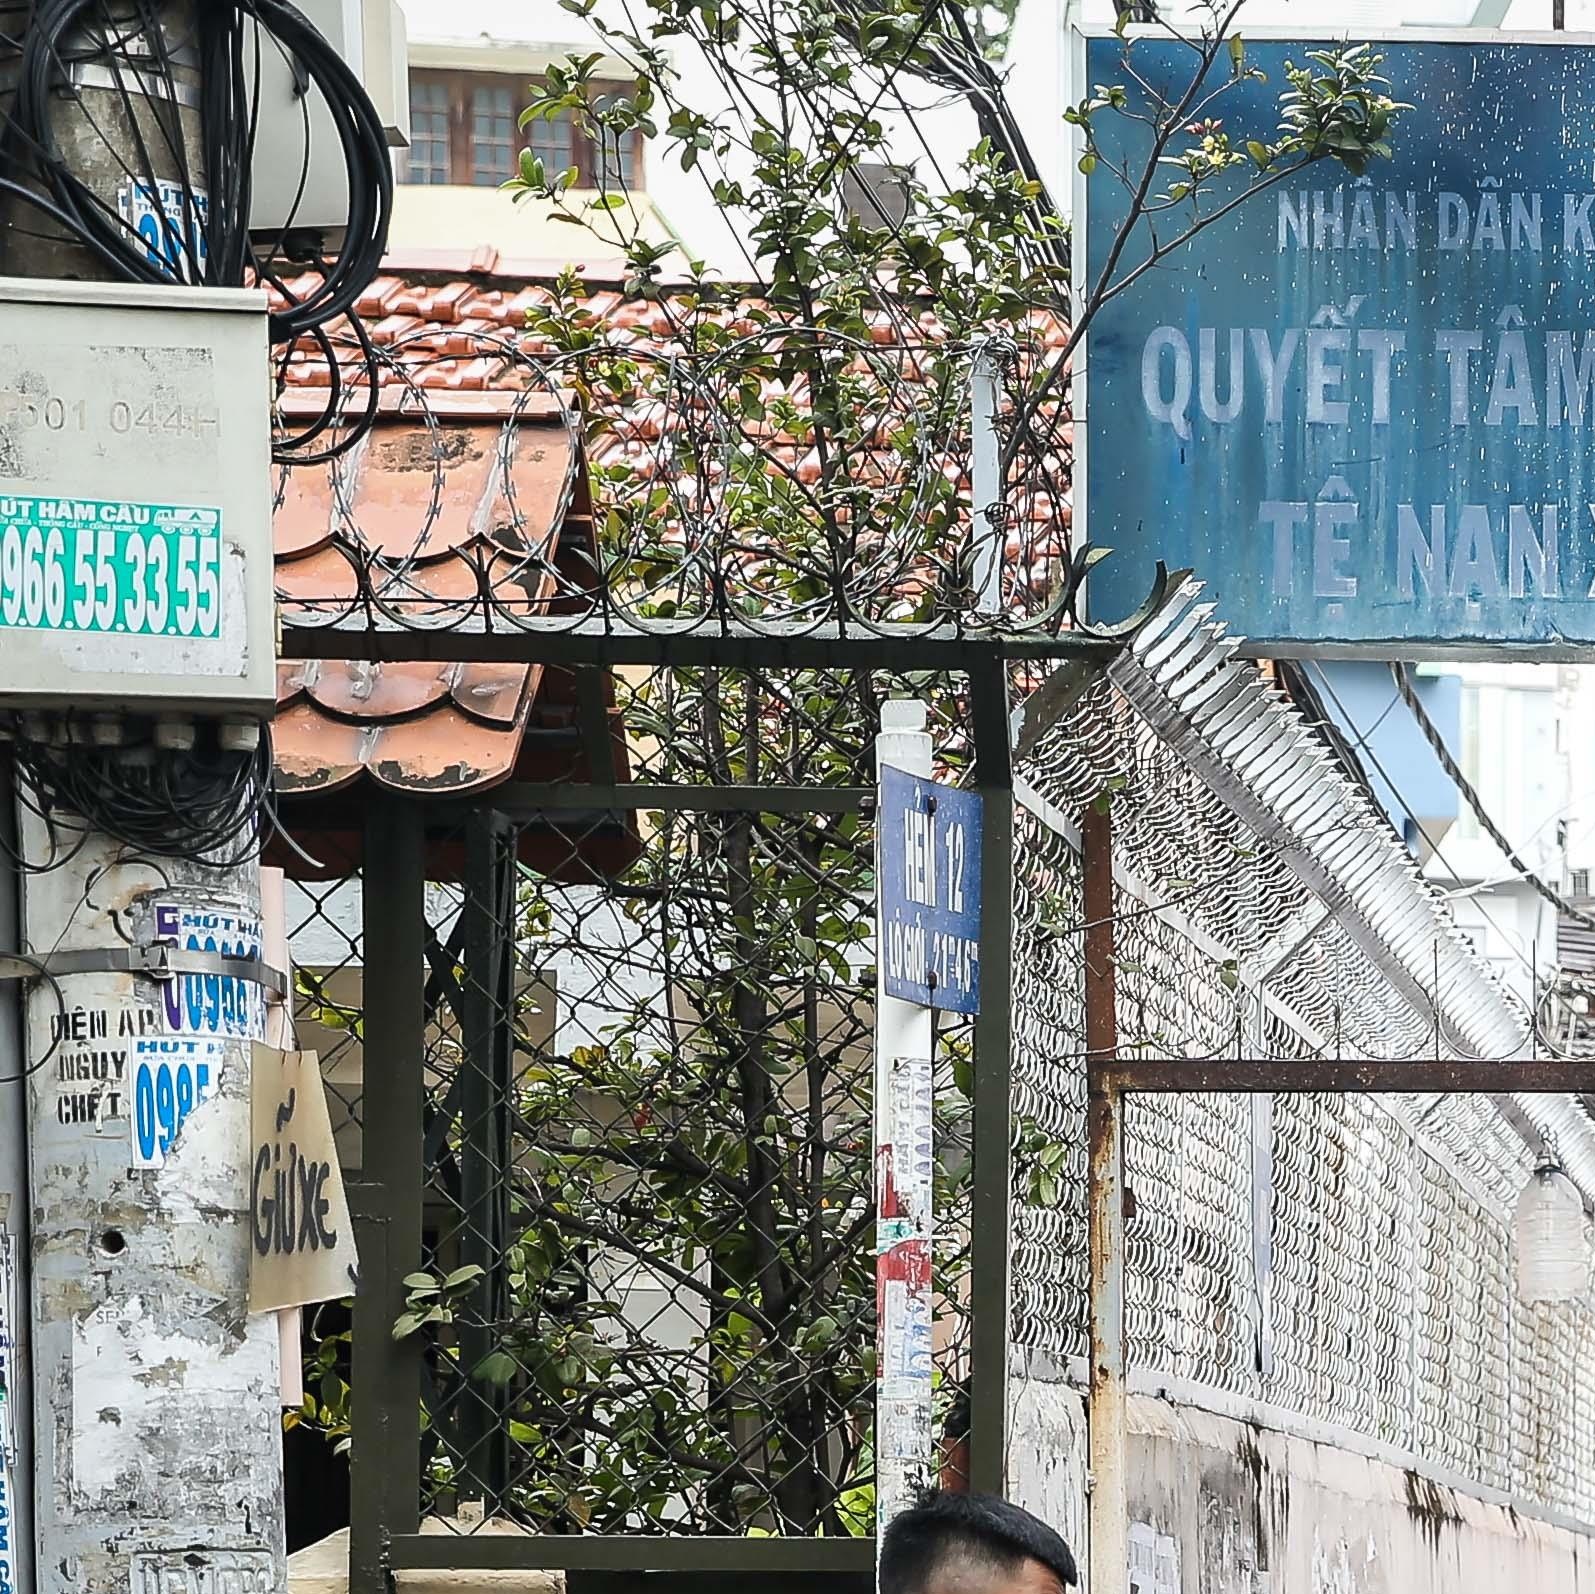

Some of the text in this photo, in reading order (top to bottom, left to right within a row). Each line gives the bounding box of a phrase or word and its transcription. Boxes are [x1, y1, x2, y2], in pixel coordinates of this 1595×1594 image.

[1276, 174, 1417, 253] NHÂN
[1437, 174, 1544, 253] DÂN
[1140, 294, 1405, 441] QUYẾT
[0, 497, 34, 516] ÚT
[1257, 474, 1360, 619] TỆ
[1399, 502, 1559, 621] NẠN
[0, 524, 220, 637] 9.66.55.33.55
[945, 822, 964, 914] 12
